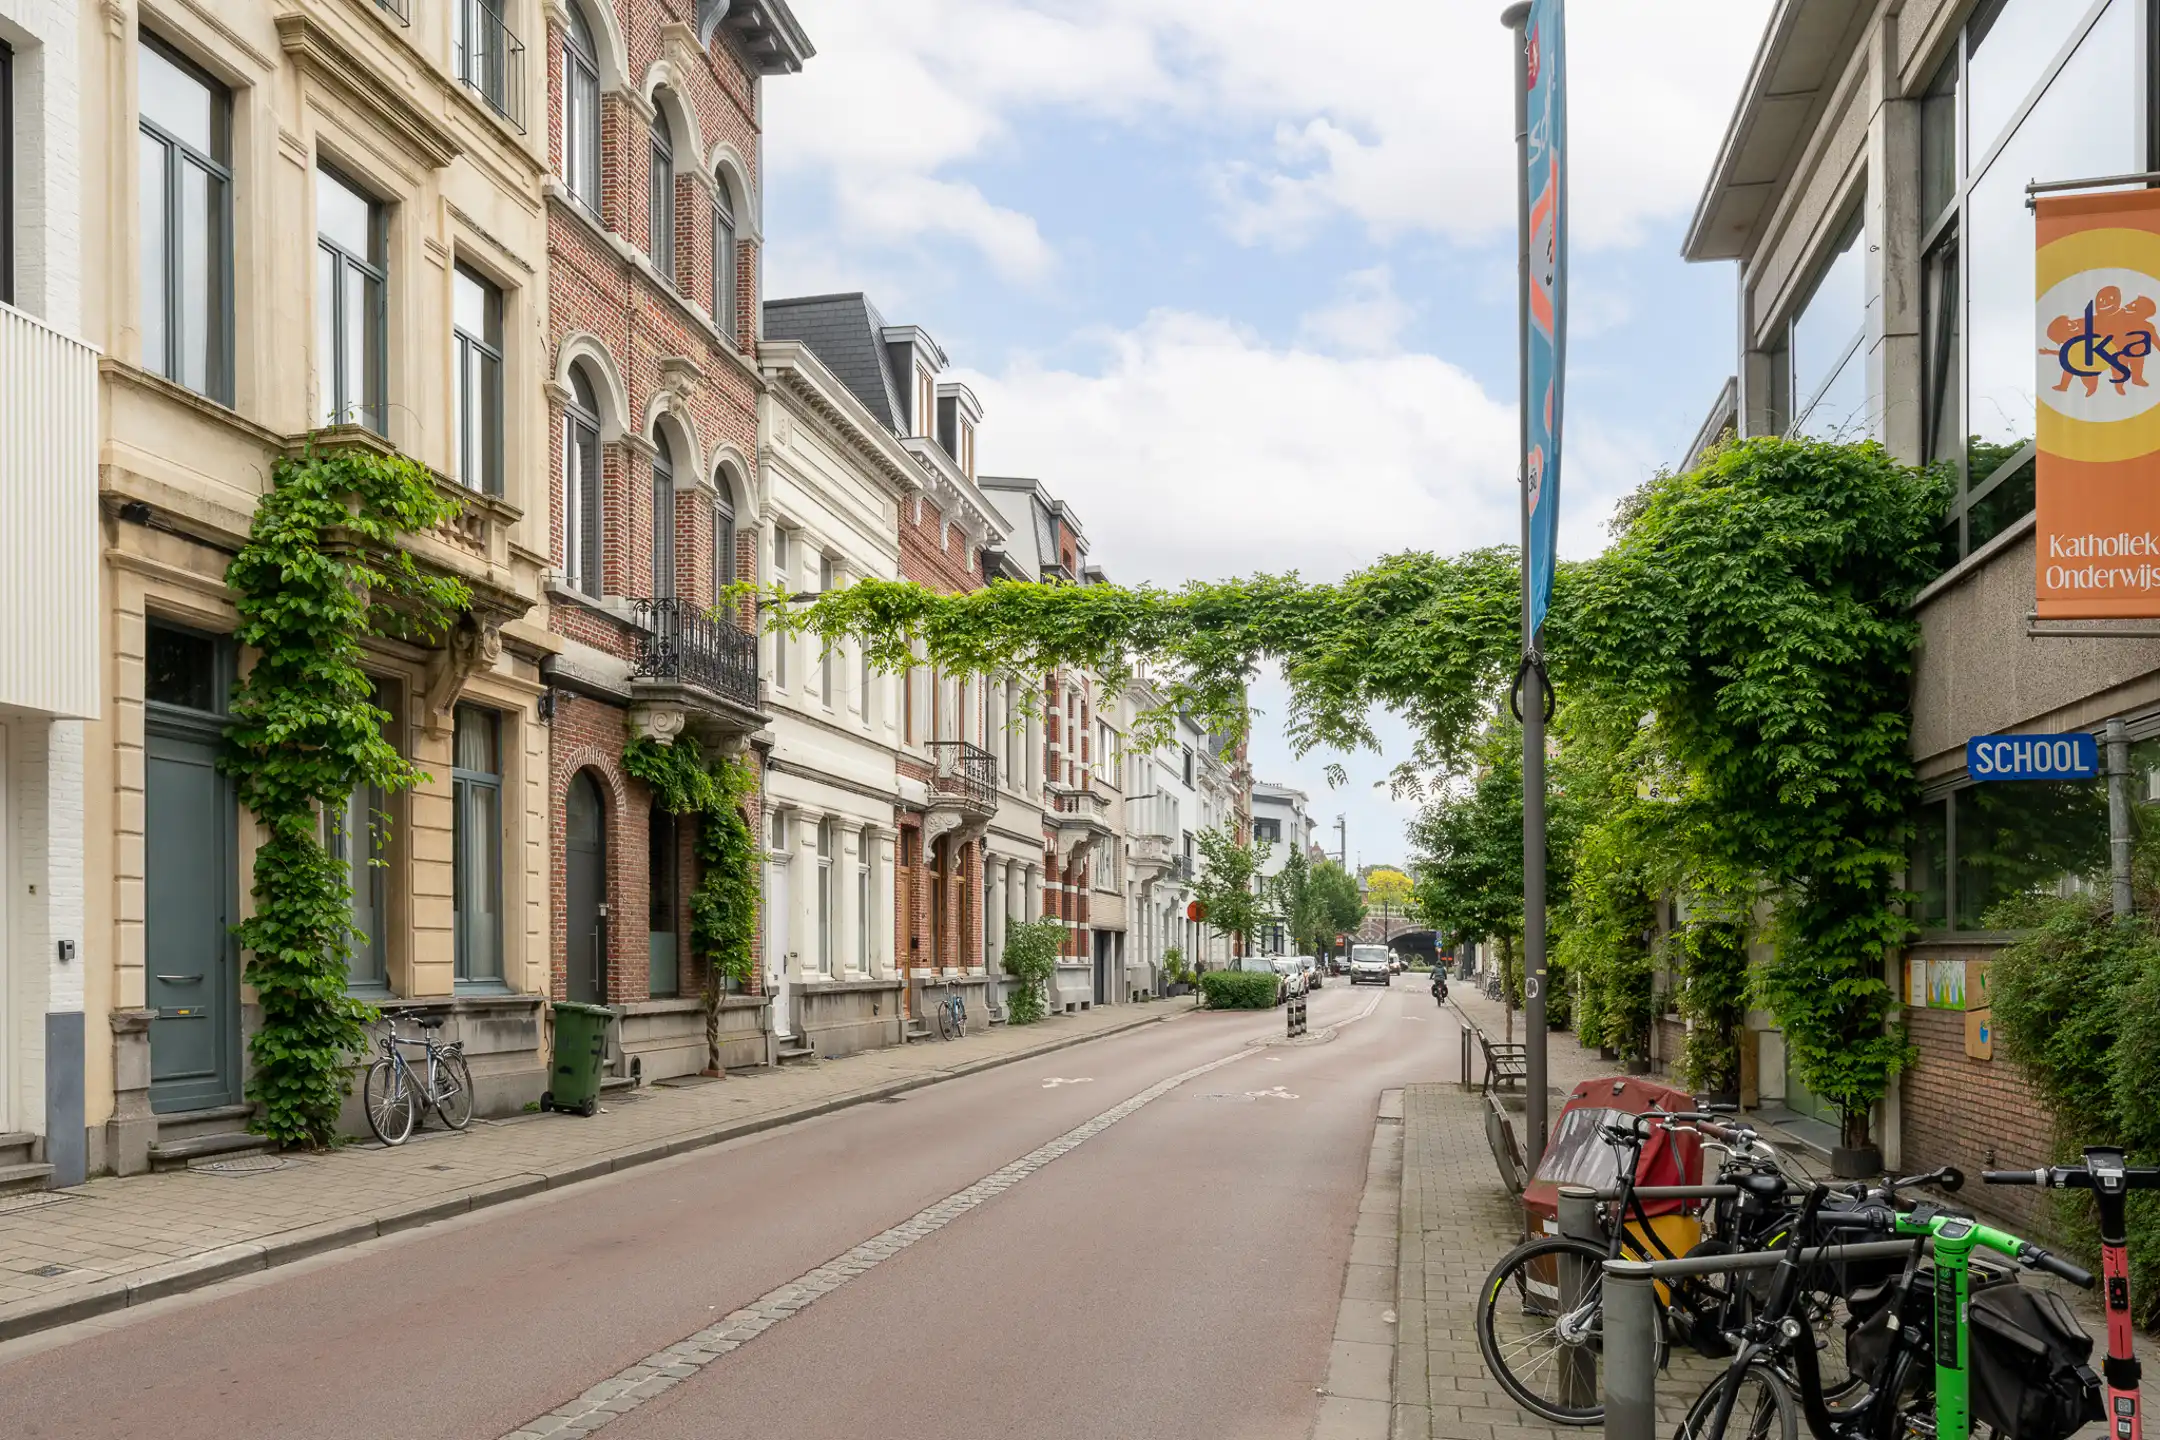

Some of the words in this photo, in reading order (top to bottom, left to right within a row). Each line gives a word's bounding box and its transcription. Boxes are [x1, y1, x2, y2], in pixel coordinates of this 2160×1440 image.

[2049, 532, 2160, 558] Katholiek
[2045, 563, 2160, 593] Onderwijs
[1975, 740, 2090, 774] SCHOOL
